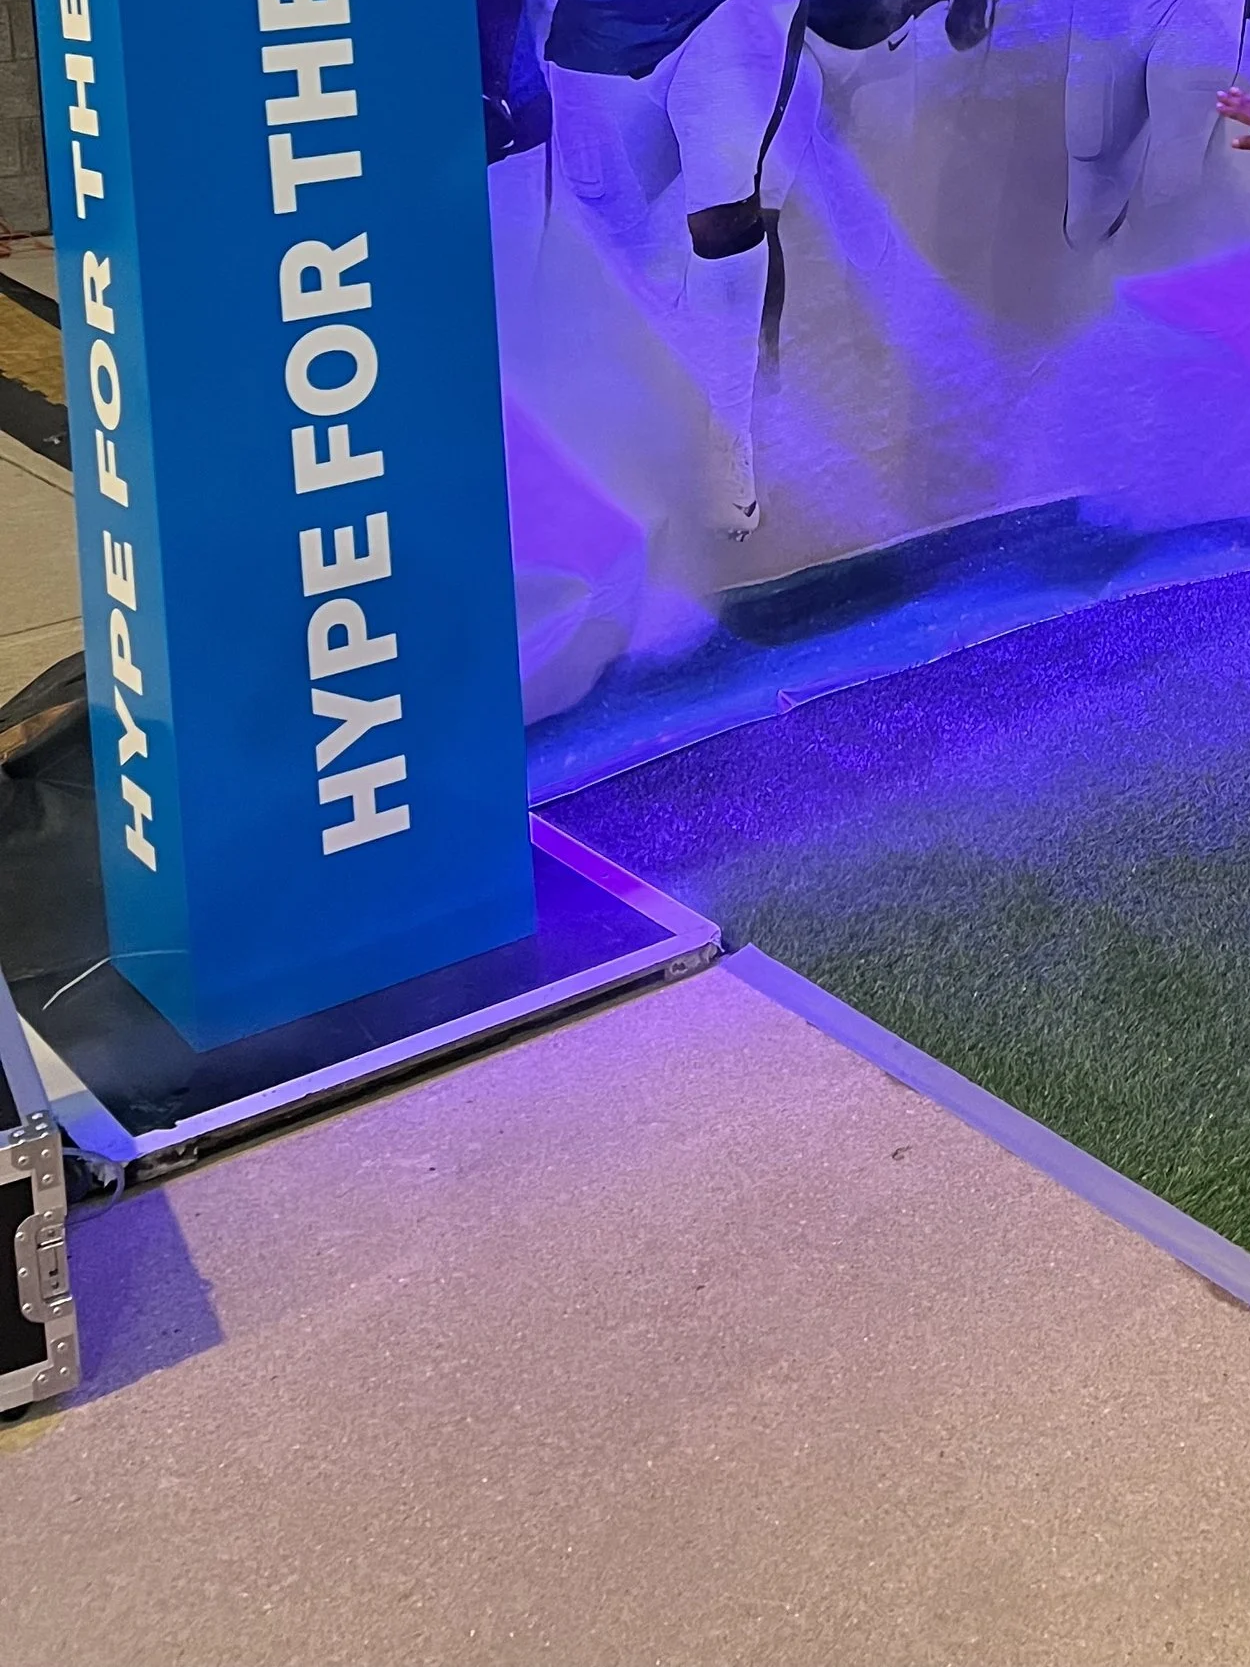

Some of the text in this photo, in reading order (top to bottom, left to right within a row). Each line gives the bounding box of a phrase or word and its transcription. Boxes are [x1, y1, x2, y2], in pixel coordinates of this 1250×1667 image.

[82, 250, 130, 509] FOR
[279, 232, 385, 495] FOR
[103, 529, 158, 874] HYPE
[299, 511, 411, 855] HYPE
